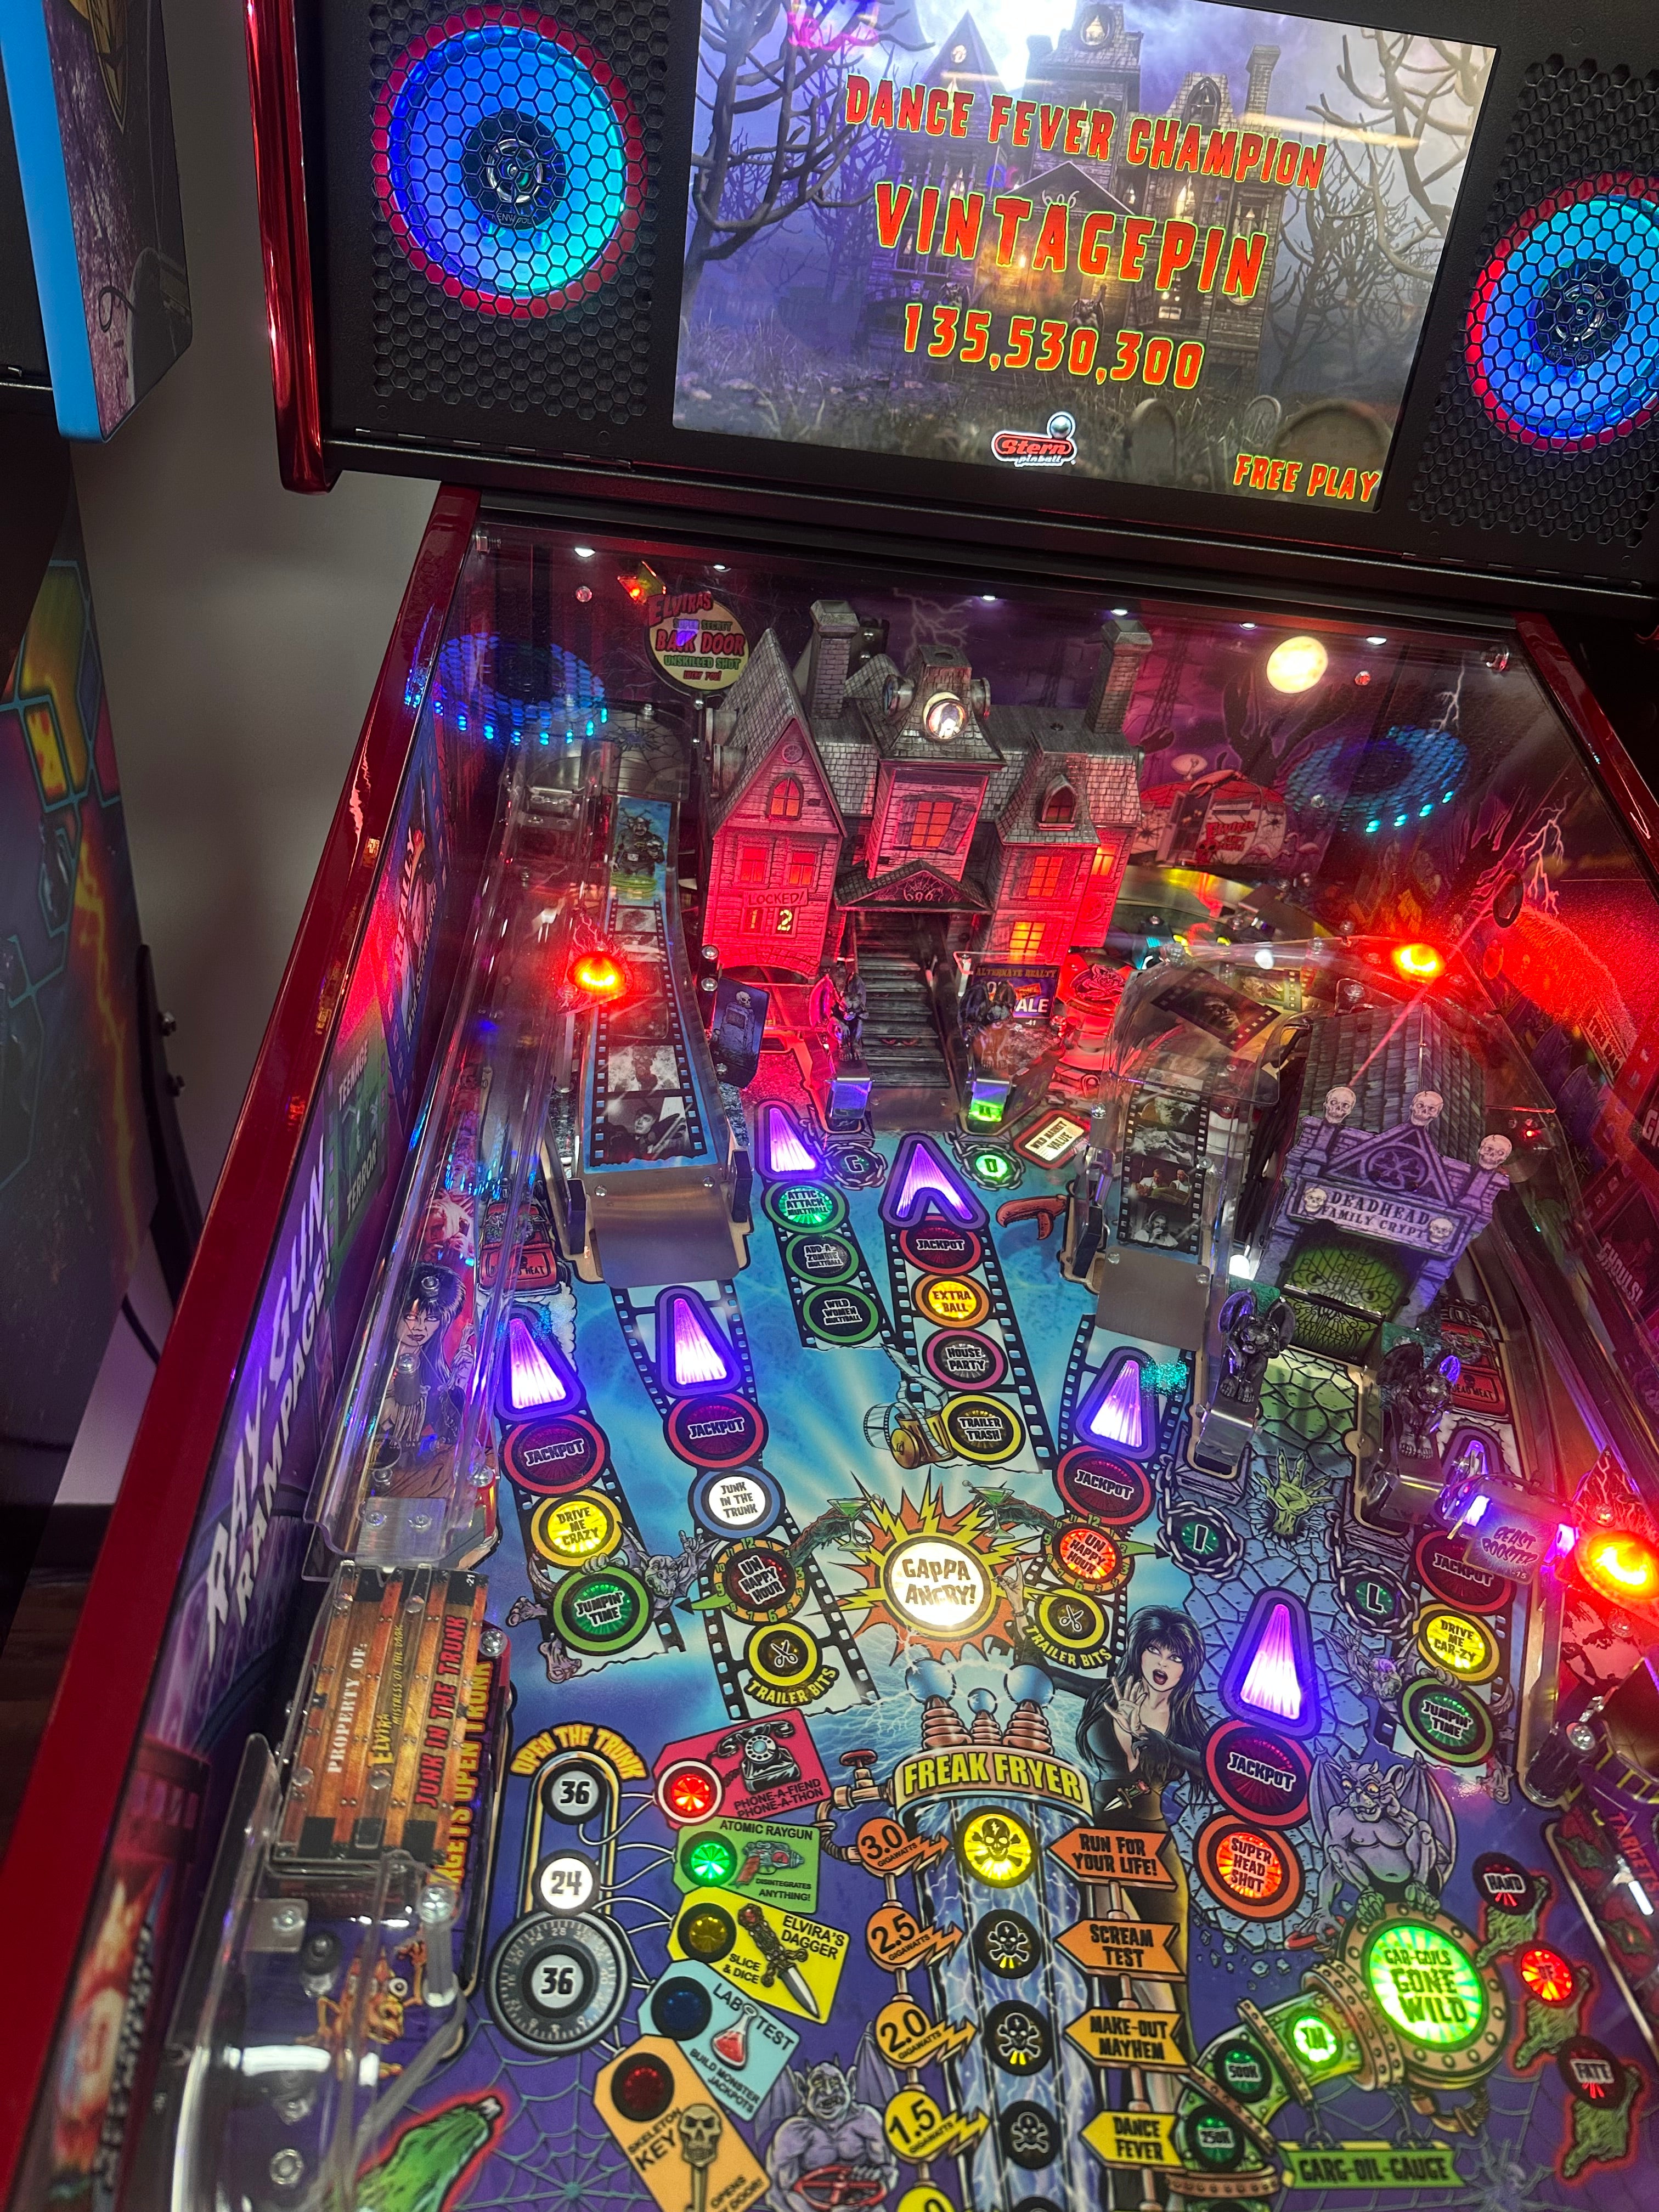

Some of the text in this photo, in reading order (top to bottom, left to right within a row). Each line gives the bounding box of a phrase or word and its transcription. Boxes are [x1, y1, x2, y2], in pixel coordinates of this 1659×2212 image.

[845, 72, 1328, 192] DANCE FEVER CHAMPION
[874, 182, 1268, 298] VINTAGEPIN
[903, 302, 1204, 391] 135,530,300
[1002, 439, 1066, 455] Stern
[1017, 455, 1062, 464] pinball
[1233, 453, 1380, 504] FREE PLAY
[701, 620, 733, 631] SECRET
[656, 629, 746, 656] BACK DOOR
[664, 655, 741, 670] UNSKILLED SHOT
[393, 826, 414, 967] REALLY
[748, 891, 805, 905] LOCKED!
[750, 909, 793, 931] 1 2
[976, 967, 1058, 978] ALTERNATE REALTY
[339, 1039, 369, 1110] TEENAGE
[1030, 1120, 1068, 1149] WILD MARKET
[1047, 1131, 1073, 1150] VALUE
[347, 1139, 377, 1221] TERROR
[786, 1198, 825, 1209] ATTACK
[787, 1190, 817, 1200] ATTIC
[787, 1206, 828, 1216] MULTIBALL
[1331, 1191, 1430, 1225] DEADHEAD
[1320, 1205, 1426, 1239] FAMILY CRYPT
[806, 1251, 838, 1262] ZOMBIE
[917, 1239, 964, 1251] JACKPOT
[825, 1299, 850, 1308] WILD
[932, 1290, 972, 1301] EXTRA
[941, 1302, 969, 1313] BALL
[823, 1306, 857, 1317] WOMEN
[947, 1348, 981, 1359] HOUSE
[948, 1359, 986, 1372] PARTY
[236, 1213, 330, 1628] RAMPAGE!
[688, 1418, 744, 1439] JACKPOT
[959, 1417, 1002, 1429] TRAILER
[965, 1427, 1001, 1441] TRASH
[524, 1438, 584, 1466] JACKPOT
[721, 1482, 747, 1494] JUNK
[1075, 1470, 1134, 1500] JACKPOT
[720, 1493, 754, 1506] IN THE
[723, 1504, 758, 1518] TRUNK
[556, 1506, 591, 1524] DRIVE
[569, 1520, 586, 1532] ME
[562, 1527, 600, 1546] CRAZY
[1085, 1534, 1106, 1552] UN
[1493, 1526, 1537, 1549] BEAST
[1067, 1551, 1097, 1575] HOUR
[1070, 1539, 1106, 1567] HAPPY
[1481, 1537, 1538, 1566] BOOSTER
[738, 1555, 764, 1575] UN
[902, 1559, 970, 1582] GAPPA
[1432, 1552, 1494, 1587] JACKPOT
[739, 1566, 777, 1592] HAPPY
[574, 1591, 624, 1617] JUMPIN'
[749, 1581, 785, 1605] HOUR
[905, 1584, 976, 1605] ANGRY!
[587, 1606, 621, 1627] TIME
[1441, 1620, 1474, 1640] DRIVE
[1448, 1634, 1464, 1647] ME
[1025, 1624, 1113, 1668] TRAILER BITS
[1434, 1638, 1476, 1663] CAR-ZY
[392, 1624, 403, 1725] MISTRESS OF THE DARK
[747, 1667, 837, 1705] TRAILER BITS
[328, 1643, 368, 1774] PROPERTY OF:
[414, 1615, 468, 1808] JUNK IN THE TRUNK
[1422, 1700, 1473, 1729] JUMPIN'
[368, 1712, 394, 1767] ELVIRA
[1430, 1717, 1463, 1739] TIME
[510, 1723, 647, 1780] OPEN THE TRUNK
[904, 1752, 1083, 1803] FREAK FRYER
[1227, 1752, 1296, 1792] JACKPOT
[558, 1780, 591, 1805] 36
[734, 1778, 821, 1810] PHONE-A-FIEND
[737, 1787, 824, 1818] PHONE-A-THON
[720, 1820, 812, 1841] ATOMIC RAYGUN
[861, 1825, 903, 1859] 3.0
[877, 1842, 918, 1867] GIGAWATTS
[1079, 1833, 1146, 1857] RUN FOR
[1231, 1837, 1272, 1864] SUPER
[1072, 1853, 1158, 1876] YOUR LIFE!
[1234, 1854, 1265, 1877] HEAD
[551, 1870, 583, 1896] 24
[755, 1878, 811, 1889] DISINTEGRATES
[1231, 1869, 1264, 1892] SHOT
[1487, 1874, 1524, 1893] HAND
[758, 1889, 811, 1901] ANYTHING!
[782, 1915, 845, 1947] ELVIRA'S
[871, 1913, 915, 1955] 2.5
[1090, 1924, 1154, 1947] SCREAM
[781, 1929, 839, 1960] DAGGER
[888, 1934, 931, 1961] GIGAWATTS
[1102, 1946, 1144, 1967] TEST
[729, 1953, 761, 1971] SLICE
[1384, 1949, 1452, 1965] GAR-GOILS
[539, 1965, 575, 1997] 36
[723, 1964, 759, 1984] & DICE
[1392, 1968, 1457, 1993] GONE
[713, 1983, 794, 2051] LAB TEST
[1398, 1996, 1468, 2023] WILD
[881, 2009, 926, 2052] 2.0
[1090, 2016, 1167, 2039] MAKE-OUT
[898, 2030, 941, 2059] GIGAWATTS
[1099, 2038, 1165, 2060] MAYHEM
[690, 2048, 761, 2104] BUILD MONSTER
[1227, 2063, 1260, 2081] 500K
[1572, 2061, 1612, 2082] FATE
[707, 2076, 754, 2114] JACKPOTS
[628, 2107, 682, 2154] SKELETON
[889, 2098, 935, 2144] 1.5
[1112, 2116, 1160, 2137] DANCE
[910, 2121, 953, 2153] GIGAWATTS
[1115, 2138, 1163, 2160] FEVER
[635, 2130, 676, 2171] KEY
[1299, 2157, 1448, 2183] GARG-OIL-GAUGE
